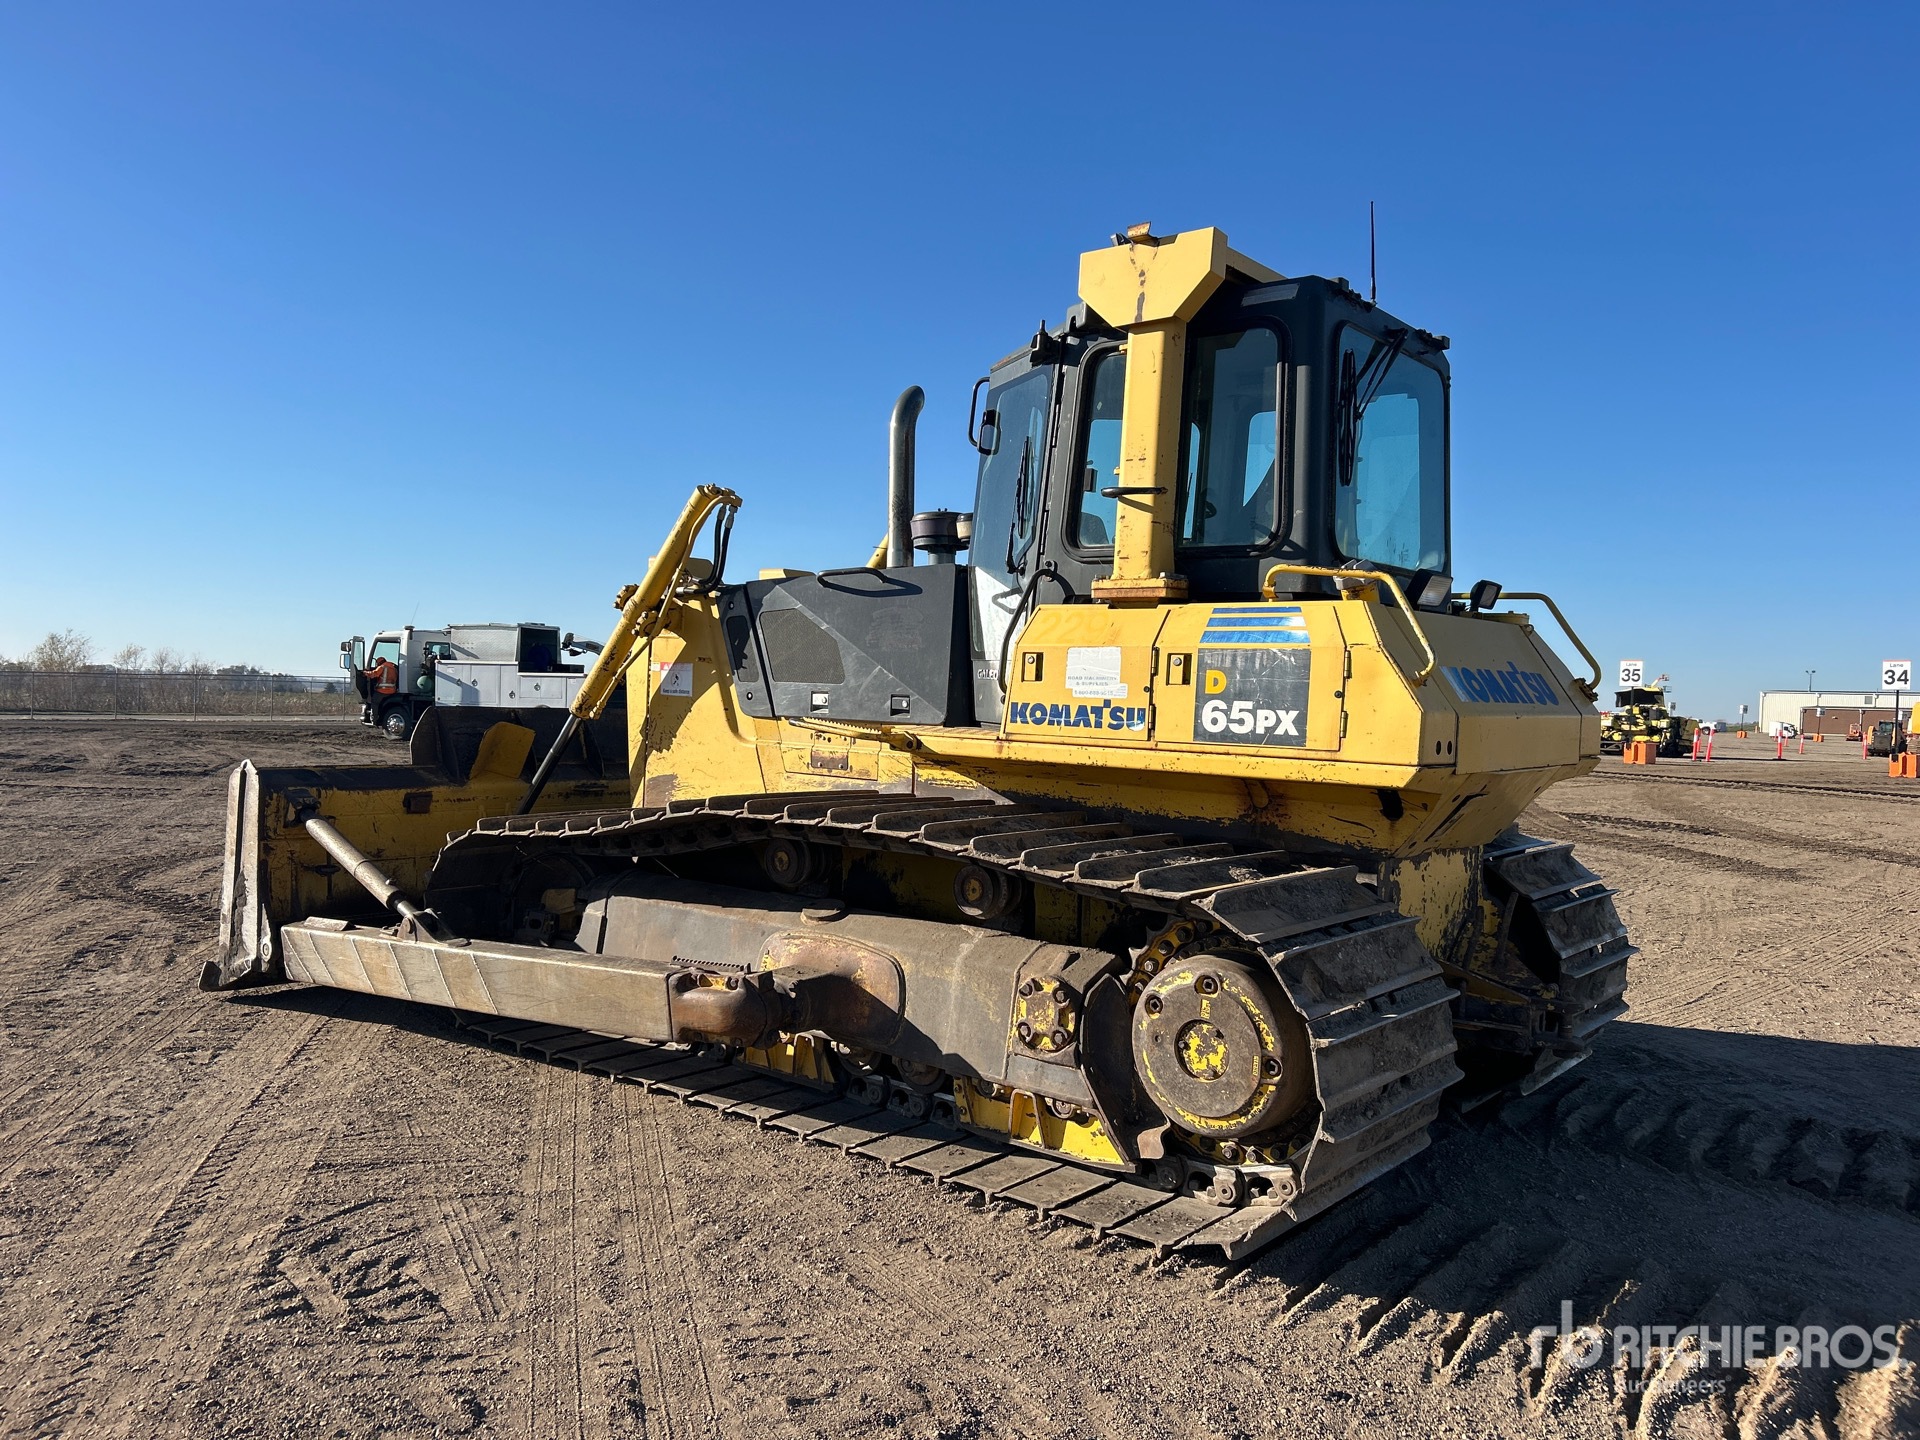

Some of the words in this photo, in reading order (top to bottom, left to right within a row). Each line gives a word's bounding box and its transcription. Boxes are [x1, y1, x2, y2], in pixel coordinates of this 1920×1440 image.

[1205, 670, 1227, 694] D
[1439, 661, 1560, 706] KOMATSU
[1621, 668, 1641, 682] 35
[1884, 669, 1909, 685] 34
[1009, 699, 1146, 731] KOMATSU
[1201, 700, 1300, 736] 65PX
